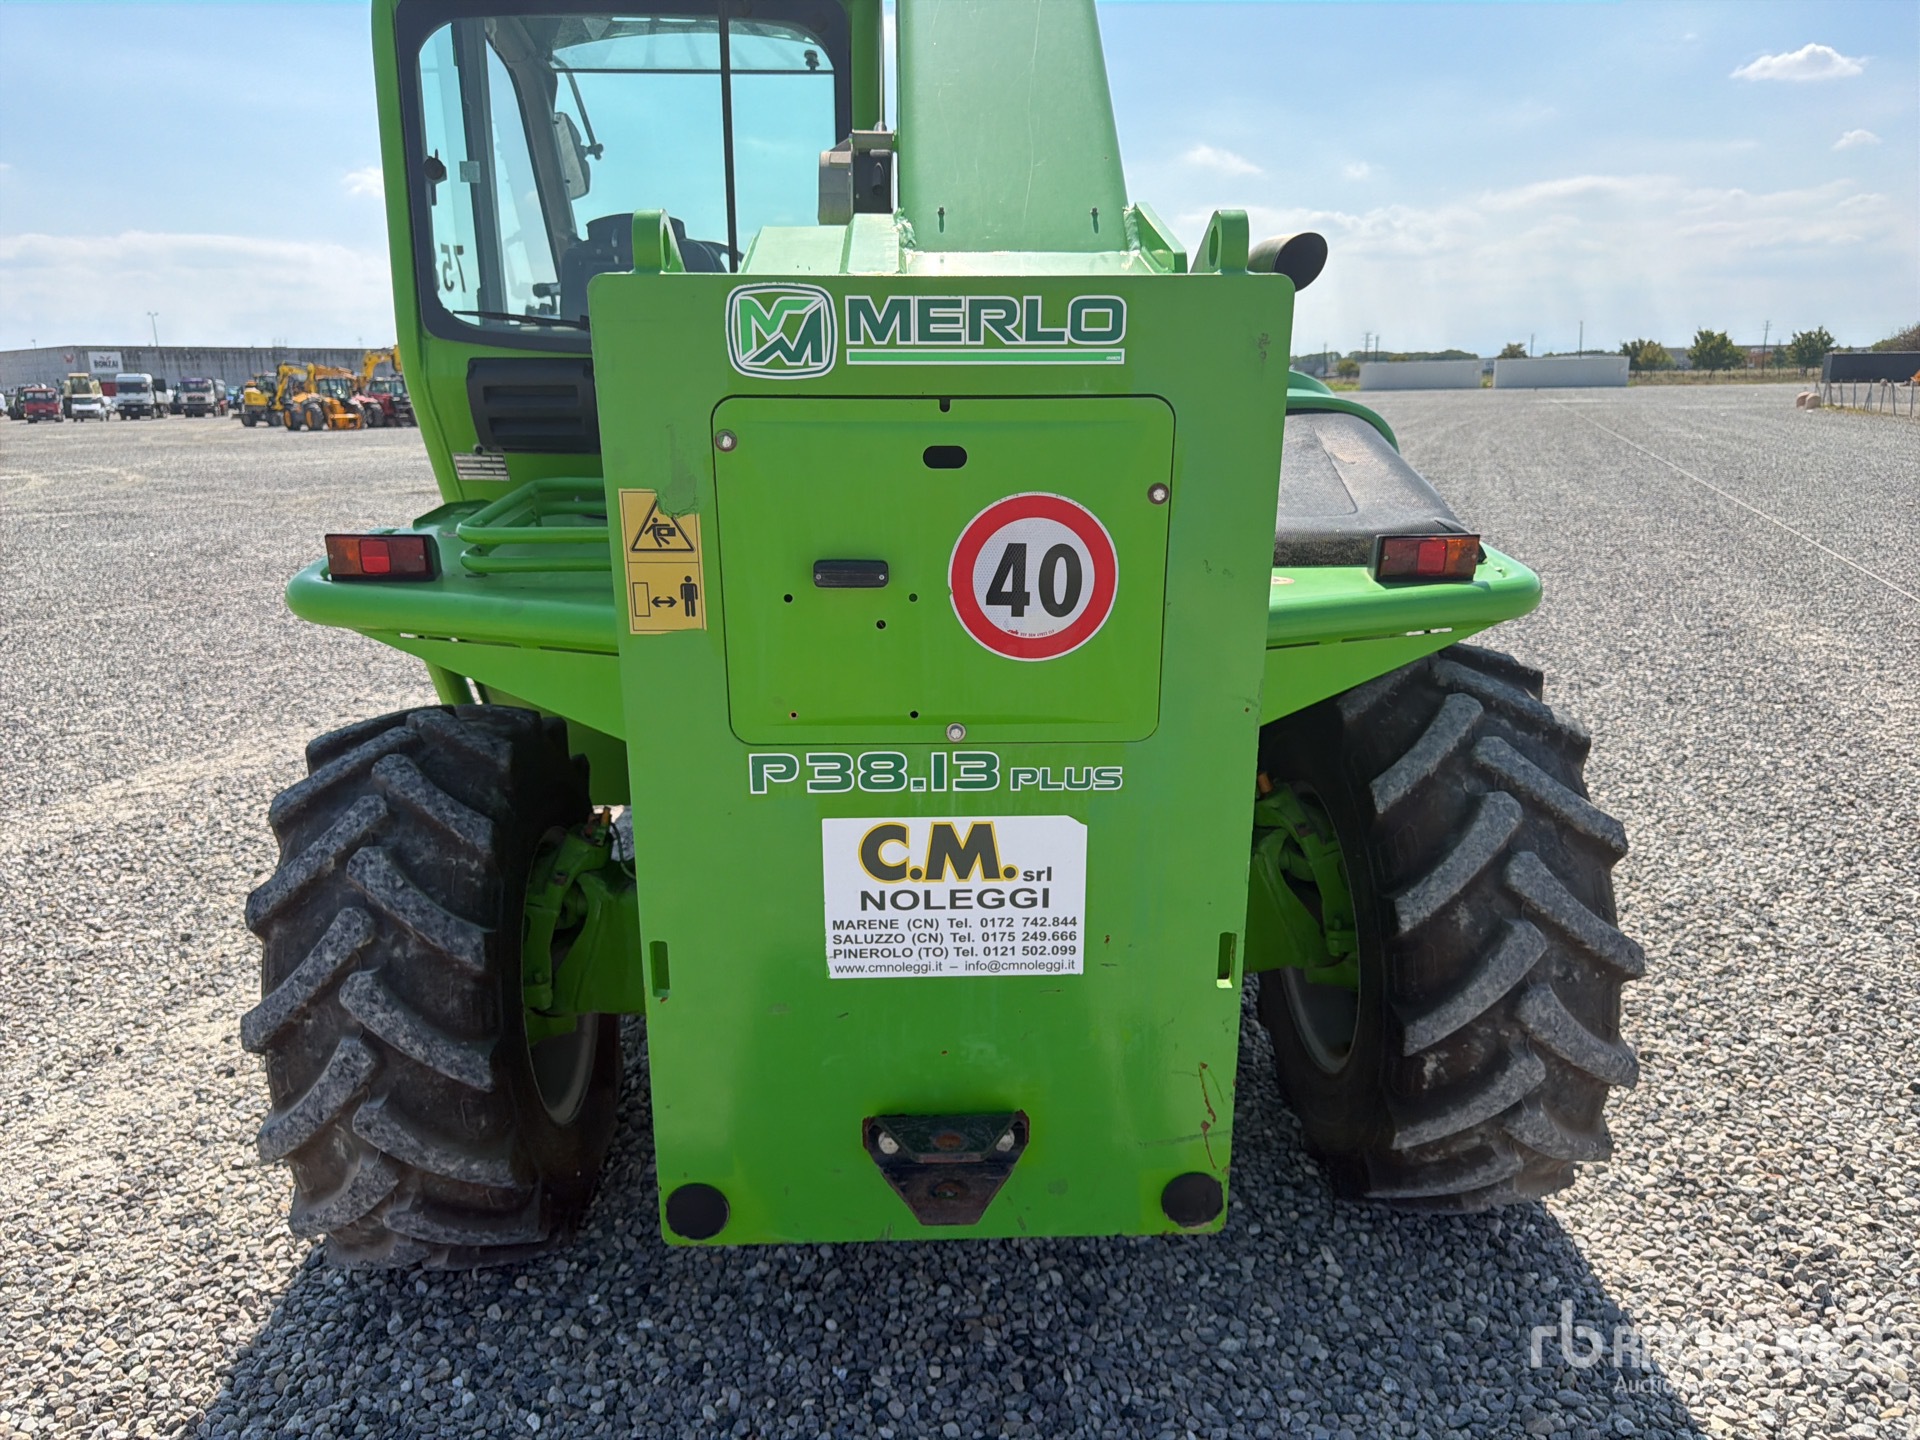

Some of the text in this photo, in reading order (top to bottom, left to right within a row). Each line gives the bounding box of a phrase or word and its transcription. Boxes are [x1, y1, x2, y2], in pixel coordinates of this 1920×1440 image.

[845, 294, 1127, 345] MERLO
[986, 543, 1083, 618] 40
[1010, 766, 1123, 791] PLUS
[858, 821, 1052, 883] C.M. srl
[860, 887, 1050, 911] NOLEGGI
[832, 916, 1077, 931] MARENE (CN) Tel. 0172 742.844
[832, 931, 1077, 945] SALUZZO (CN) Tel. 0175 249.666
[833, 945, 1077, 960] PINEROLO (TO) Tel. 0121 502.099
[835, 961, 943, 974] www.cmnoleggi.it
[965, 960, 1075, 973] info@cmnoleggi.it
